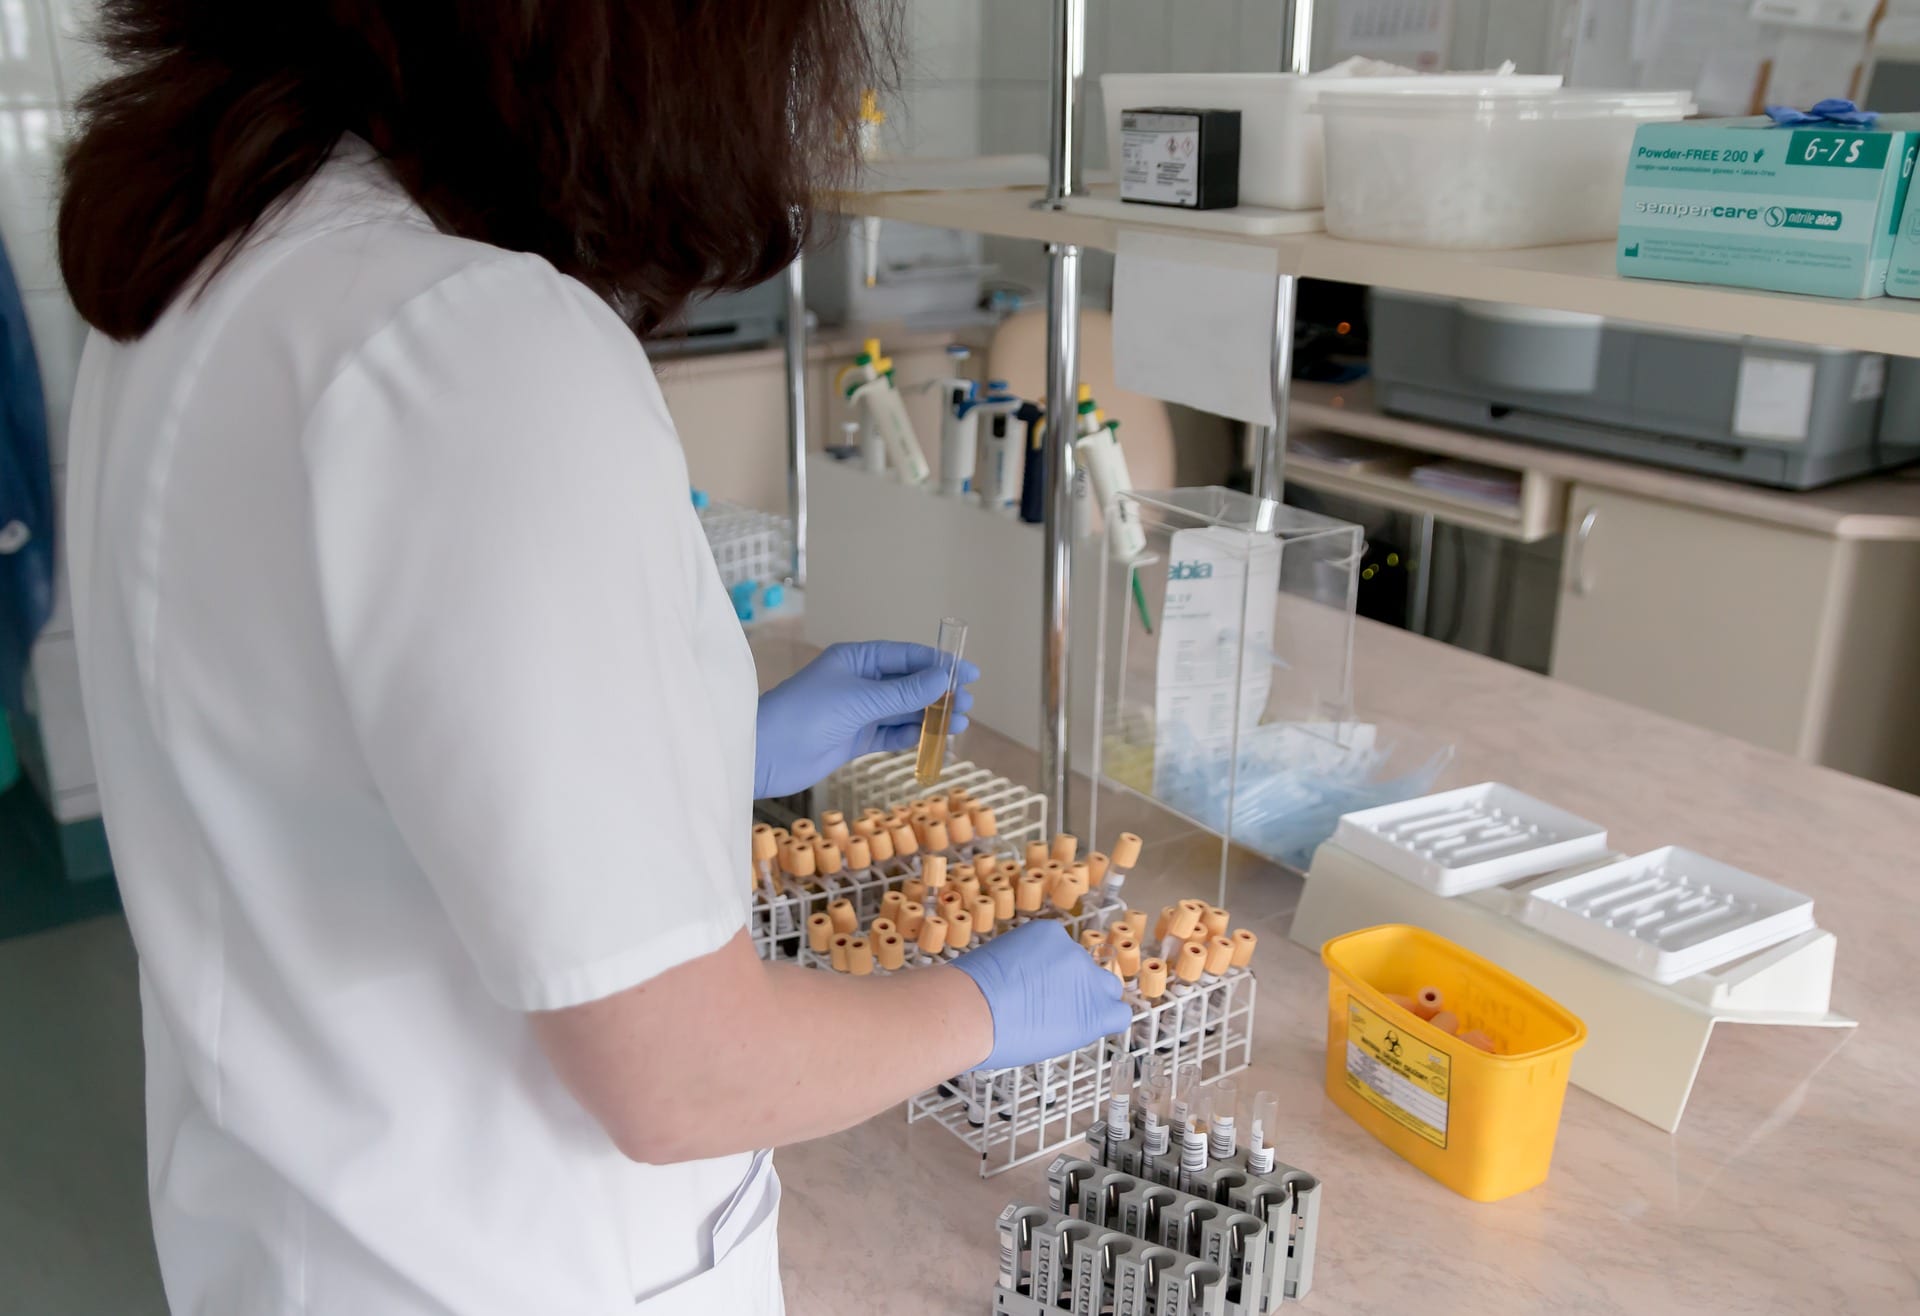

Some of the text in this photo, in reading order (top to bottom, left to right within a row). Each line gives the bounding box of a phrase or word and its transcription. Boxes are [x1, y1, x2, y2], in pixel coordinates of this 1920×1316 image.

[1637, 146, 1748, 163] Powder-FREE 200
[1804, 138, 1864, 163] 6-7 S
[1635, 200, 1838, 226] sempercare nitrile aloe
